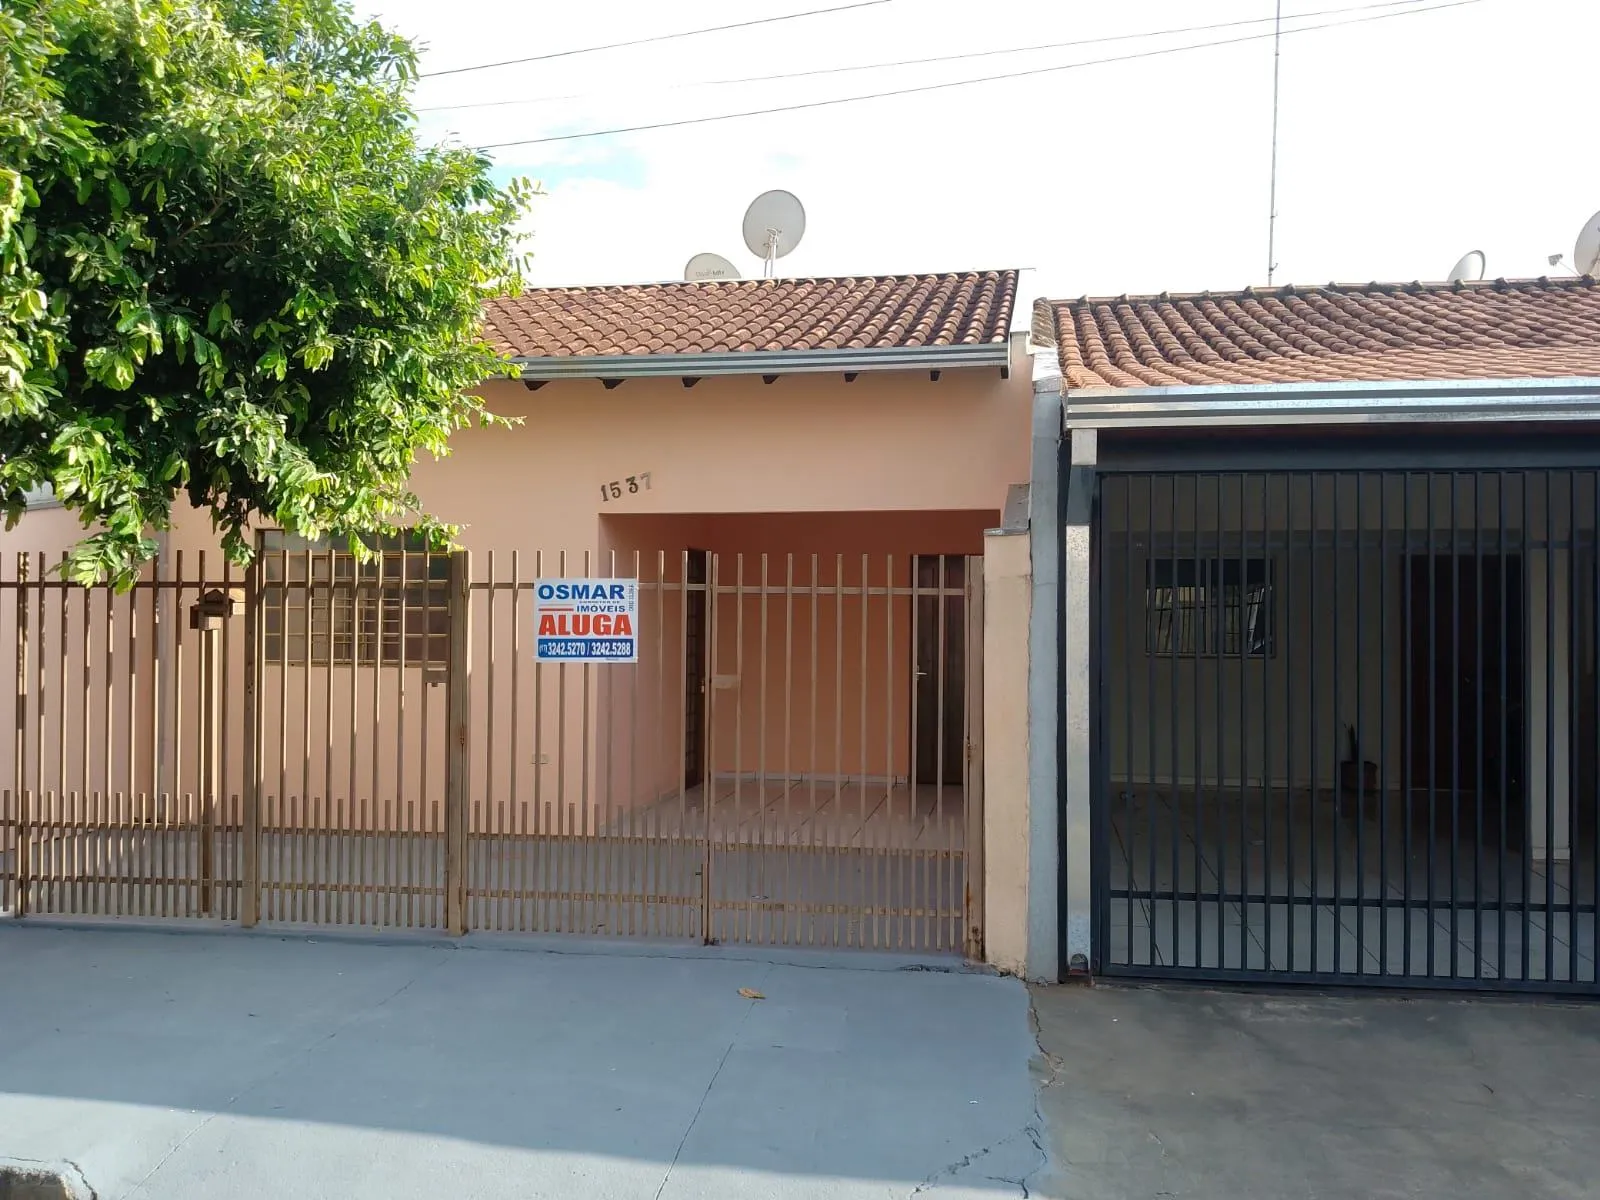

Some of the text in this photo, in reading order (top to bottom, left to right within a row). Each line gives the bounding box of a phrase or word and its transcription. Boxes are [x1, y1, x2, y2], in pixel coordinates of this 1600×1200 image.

[601, 471, 652, 501] 1537
[538, 584, 625, 600] OSMAR
[576, 604, 626, 613] IMÓVEIS
[538, 614, 633, 636] ALUGA
[547, 642, 585, 656] 3242.5270
[591, 642, 631, 656] 3242.5288
